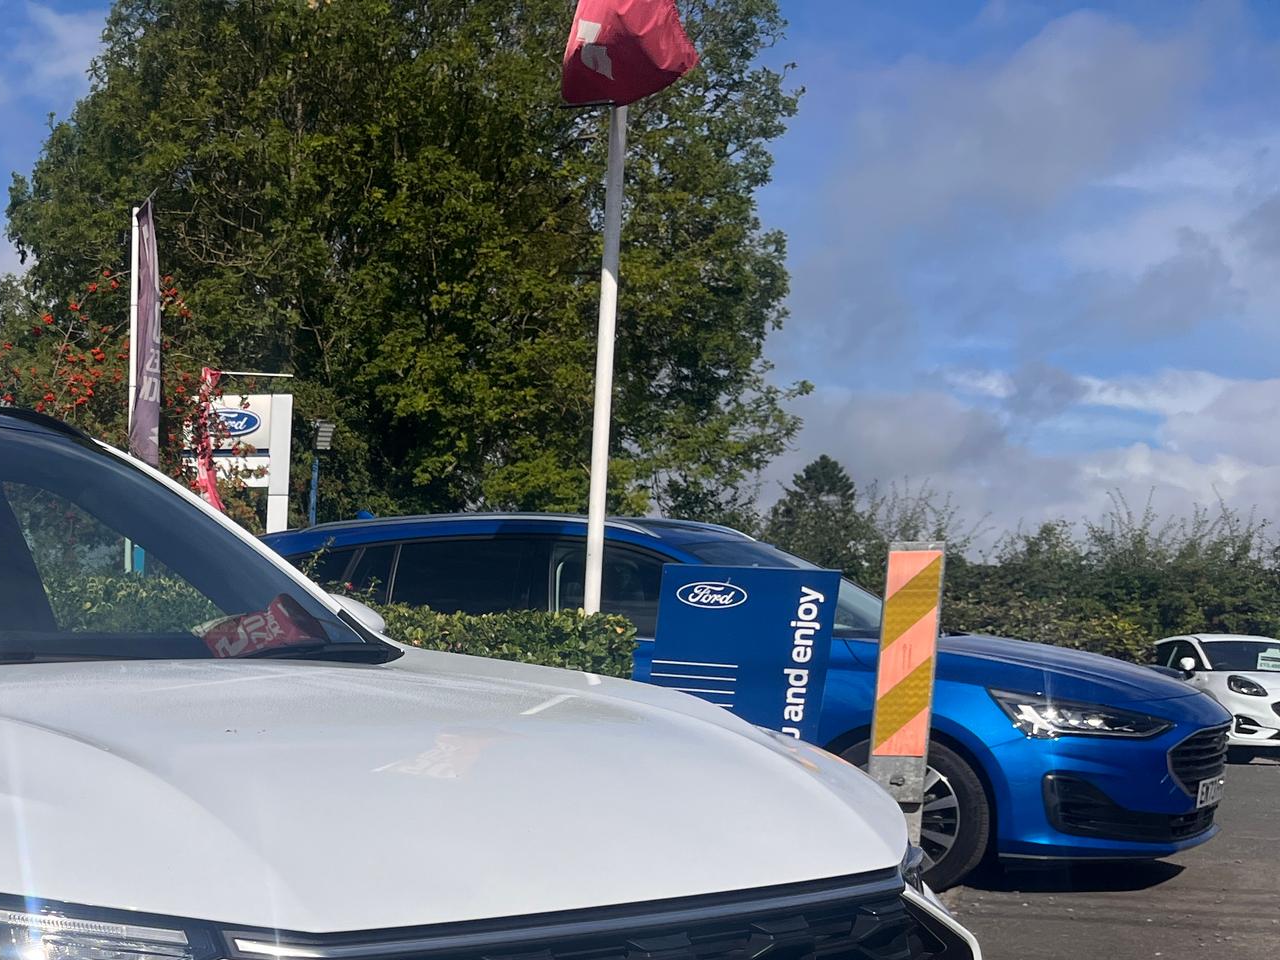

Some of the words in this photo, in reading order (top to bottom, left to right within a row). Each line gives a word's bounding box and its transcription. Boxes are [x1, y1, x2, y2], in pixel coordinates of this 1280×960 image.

[688, 585, 735, 604] Ford
[790, 586, 825, 663] enjoy
[784, 668, 809, 722] and
